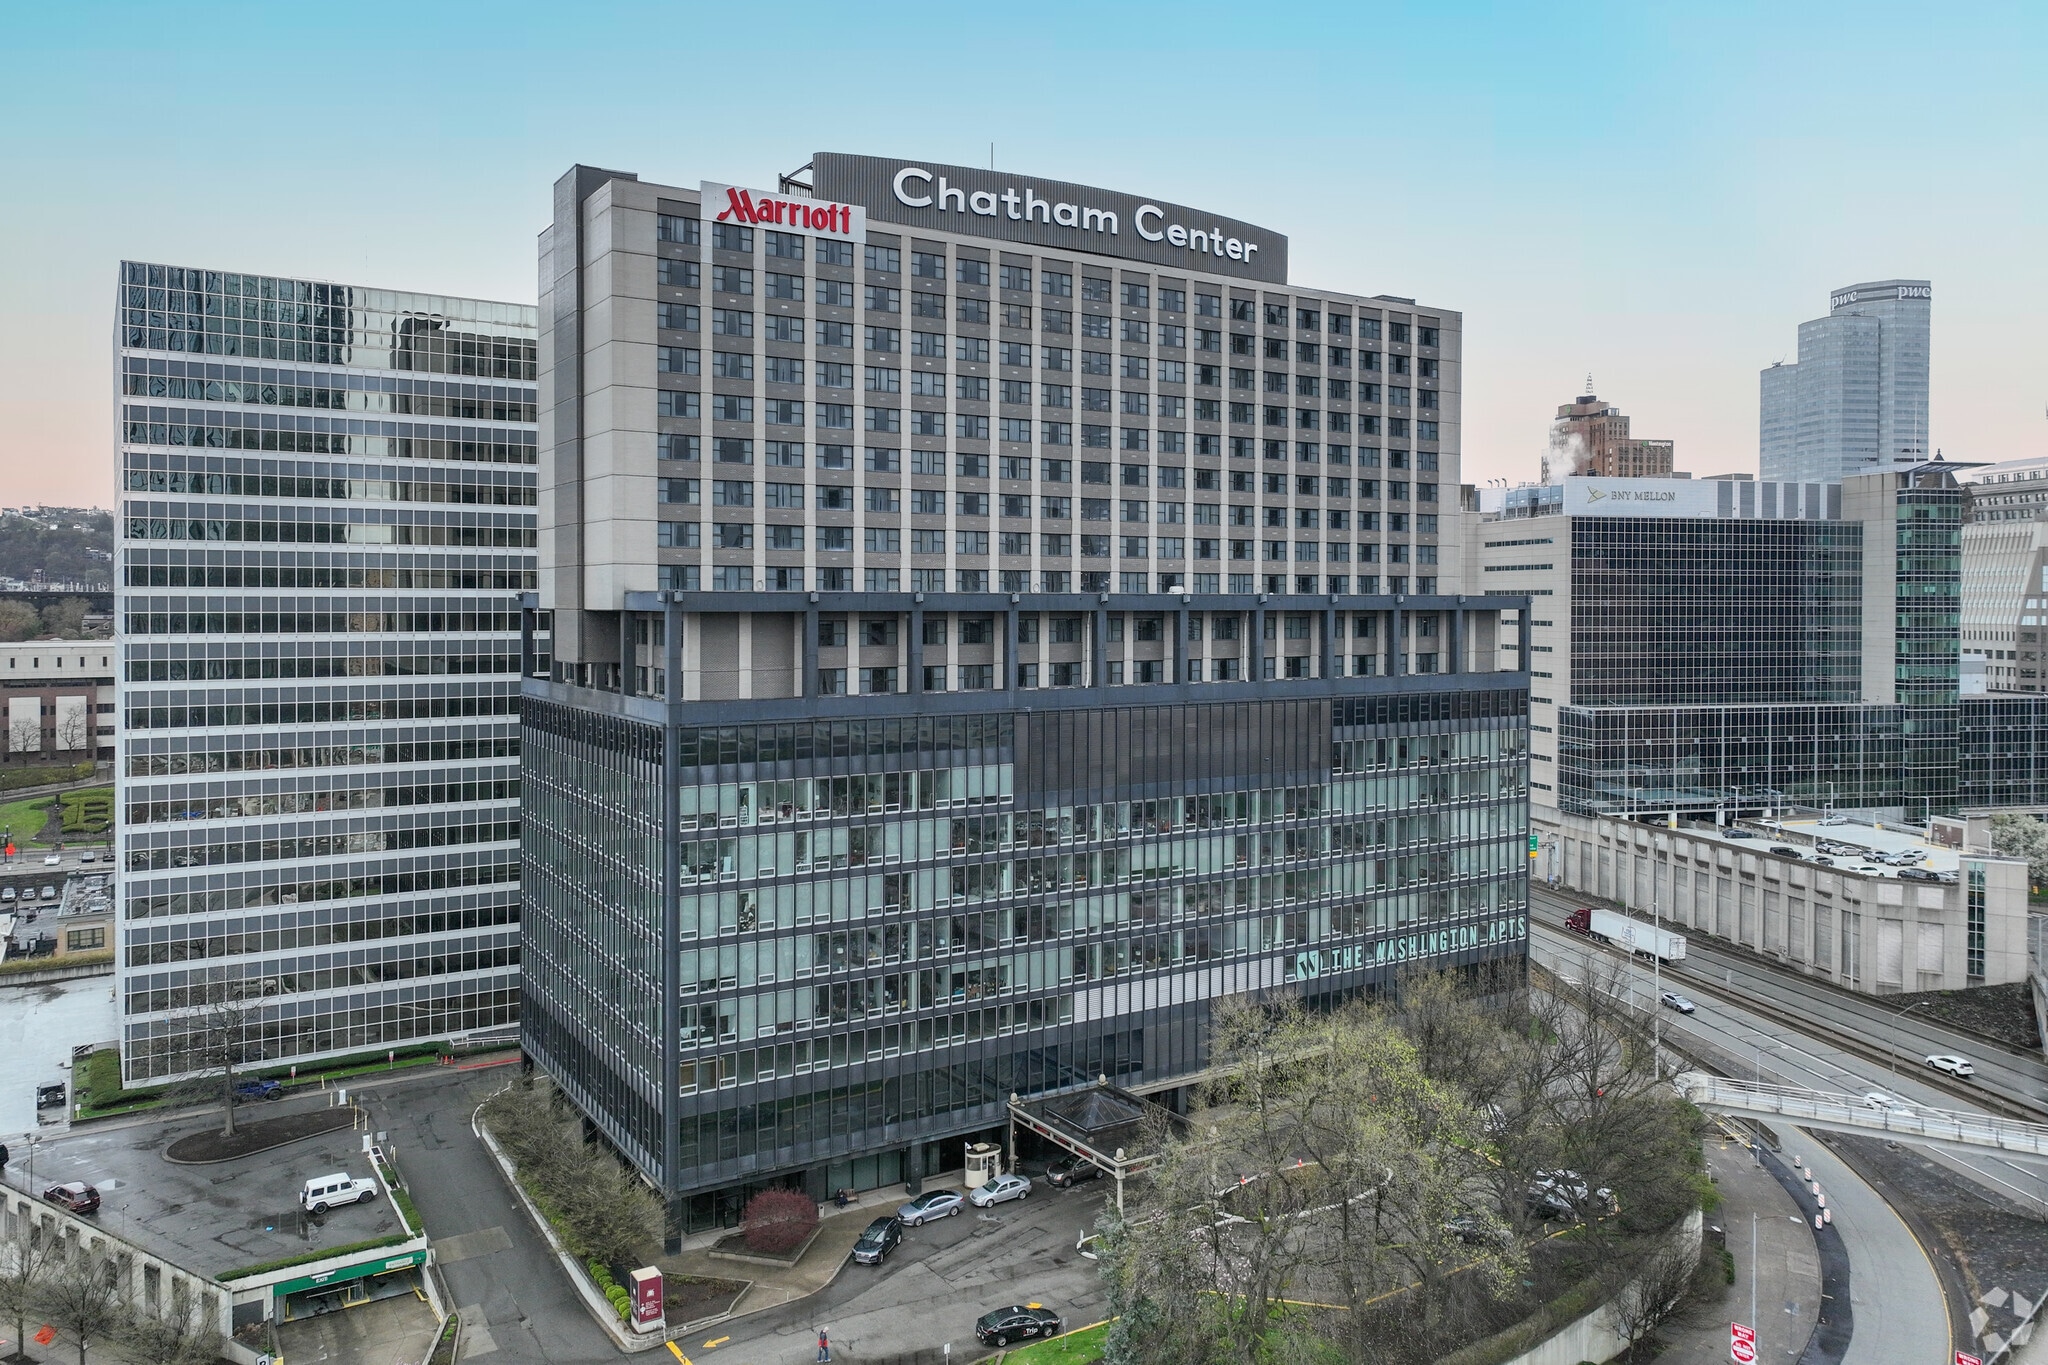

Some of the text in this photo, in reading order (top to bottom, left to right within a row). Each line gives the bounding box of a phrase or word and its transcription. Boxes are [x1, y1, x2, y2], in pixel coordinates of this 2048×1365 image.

[716, 187, 851, 234] Marriott
[893, 167, 1259, 264] Chatham Center
[1896, 286, 1931, 300] pwc
[1831, 291, 1858, 310] pwc
[1611, 491, 1676, 502] BNY MELLON
[1332, 945, 1363, 971] THE
[1376, 924, 1478, 963] WASHINGTON
[1489, 916, 1526, 946] APTS
[1734, 1324, 1753, 1336] WRONG
[1737, 1331, 1749, 1340] WAY
[1958, 1353, 1979, 1365] WRONG
